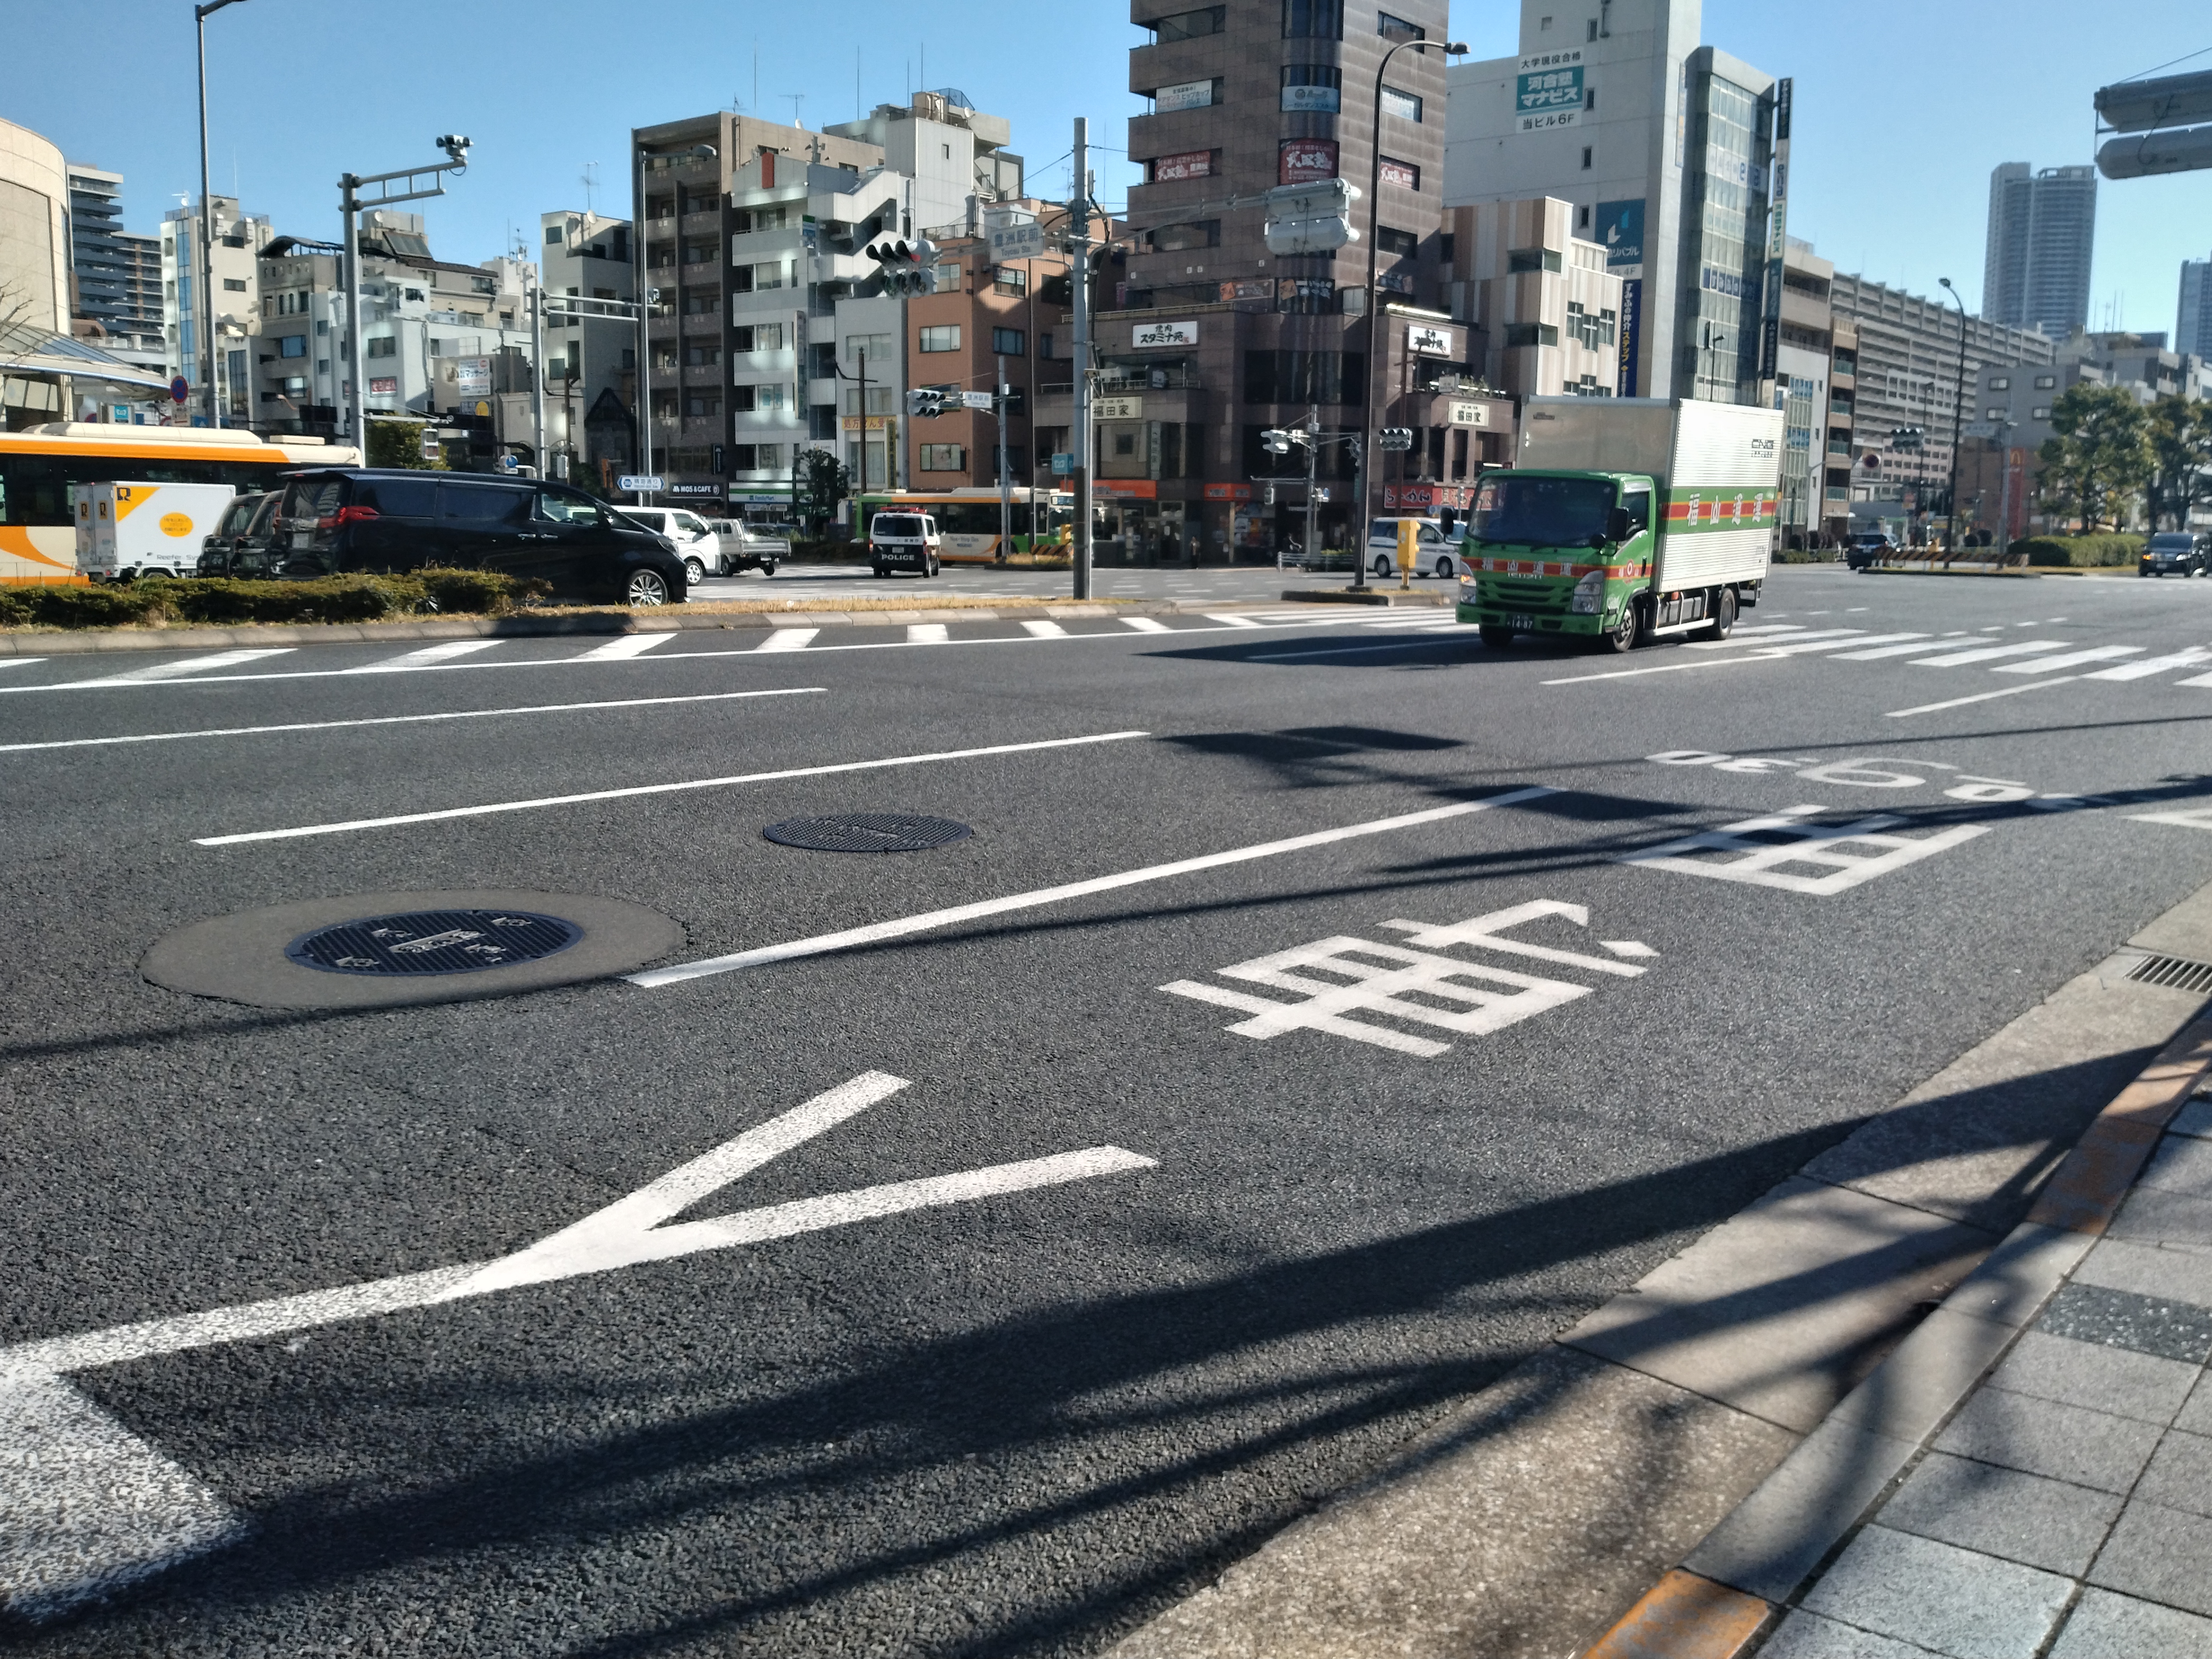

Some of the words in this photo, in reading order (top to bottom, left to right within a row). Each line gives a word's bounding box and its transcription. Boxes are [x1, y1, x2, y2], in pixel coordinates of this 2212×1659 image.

[1521, 52, 1580, 69] 大学現役合格
[1528, 71, 1572, 91] 河合塾
[1521, 87, 1578, 107] マナビス
[994, 228, 1038, 247] 豊洲駅前
[1140, 331, 1184, 343] スタミナ苑
[1093, 405, 1129, 417] 福田家
[1687, 492, 1763, 527] 福山通運
